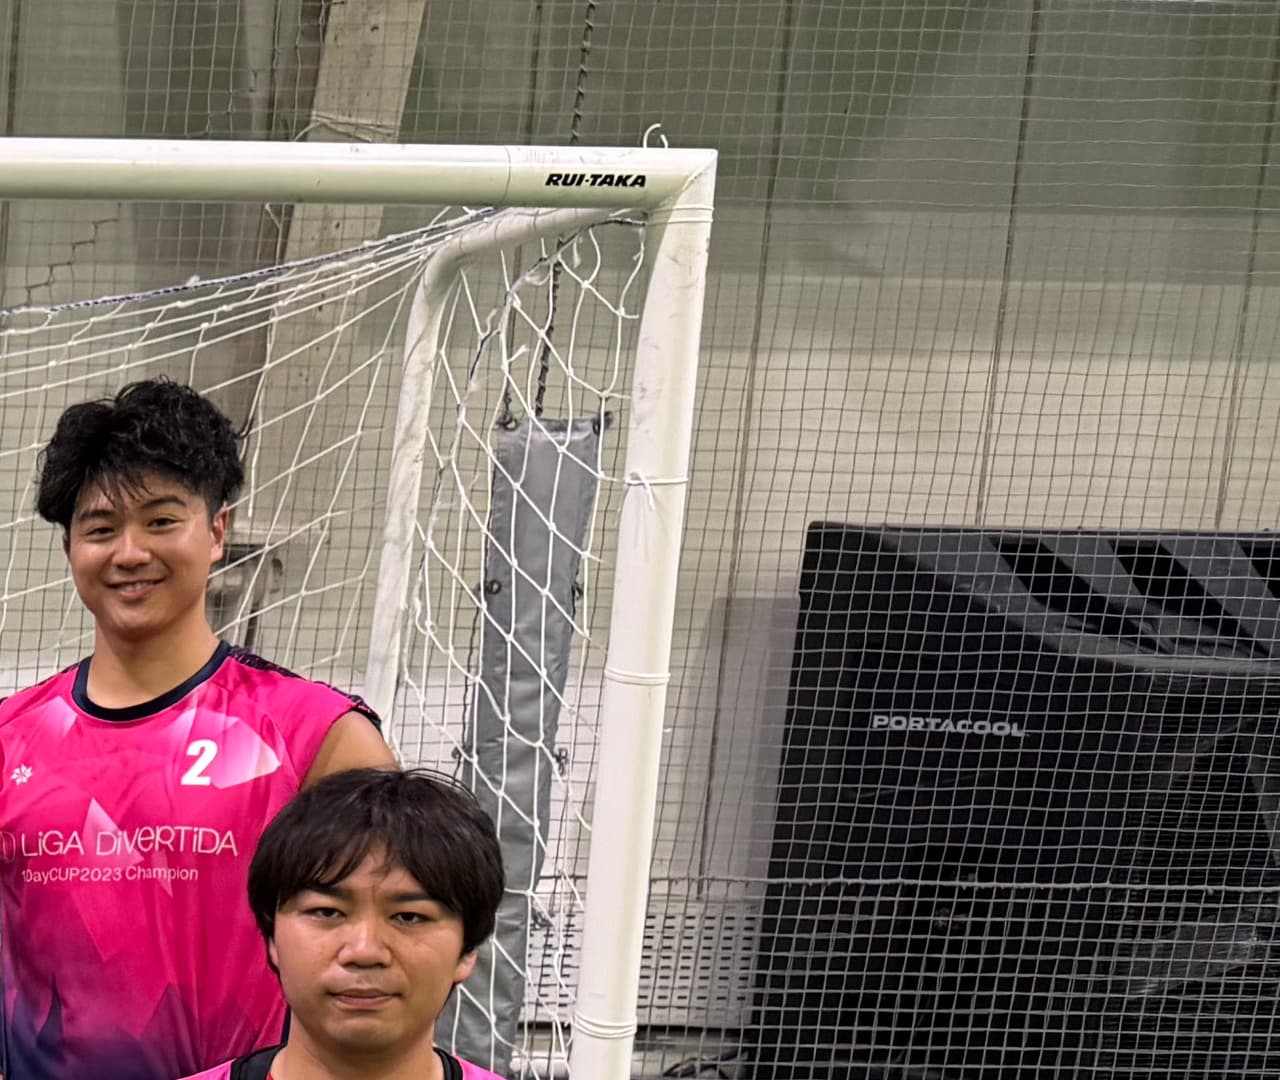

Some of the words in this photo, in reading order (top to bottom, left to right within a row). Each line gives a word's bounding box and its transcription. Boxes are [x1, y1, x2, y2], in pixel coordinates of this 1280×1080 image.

[872, 714, 1027, 737] PORTACOOL
[181, 739, 217, 786] 2
[125, 865, 199, 884] Champion
